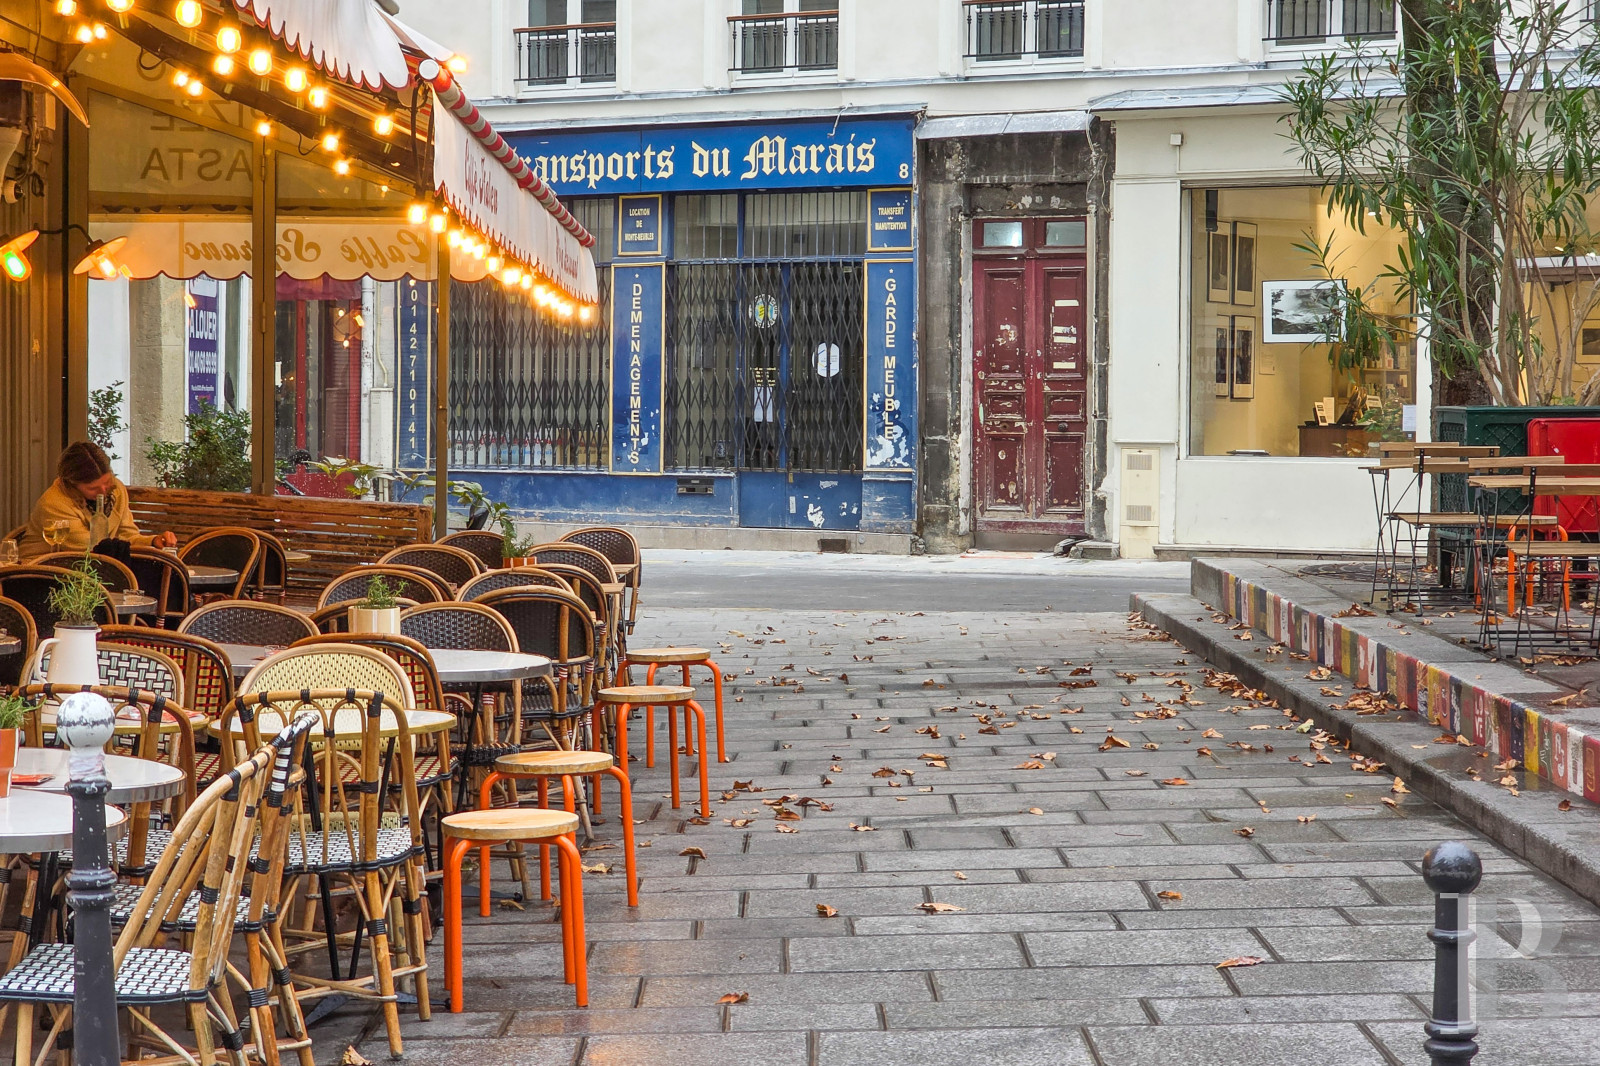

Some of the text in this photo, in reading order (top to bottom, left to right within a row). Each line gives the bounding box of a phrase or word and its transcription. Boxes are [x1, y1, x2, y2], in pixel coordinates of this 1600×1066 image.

[513, 133, 876, 189] ansports du Marais
[898, 163, 910, 179] 8
[629, 207, 651, 217] LOCATION
[877, 206, 905, 216] TRANSFERT
[635, 219, 643, 228] DE
[874, 221, 908, 231] MANUTENTION
[195, 309, 217, 341] LOUER
[884, 278, 897, 440] GARDE MEUBLE
[629, 283, 643, 464] DEMENAGEMENTS
